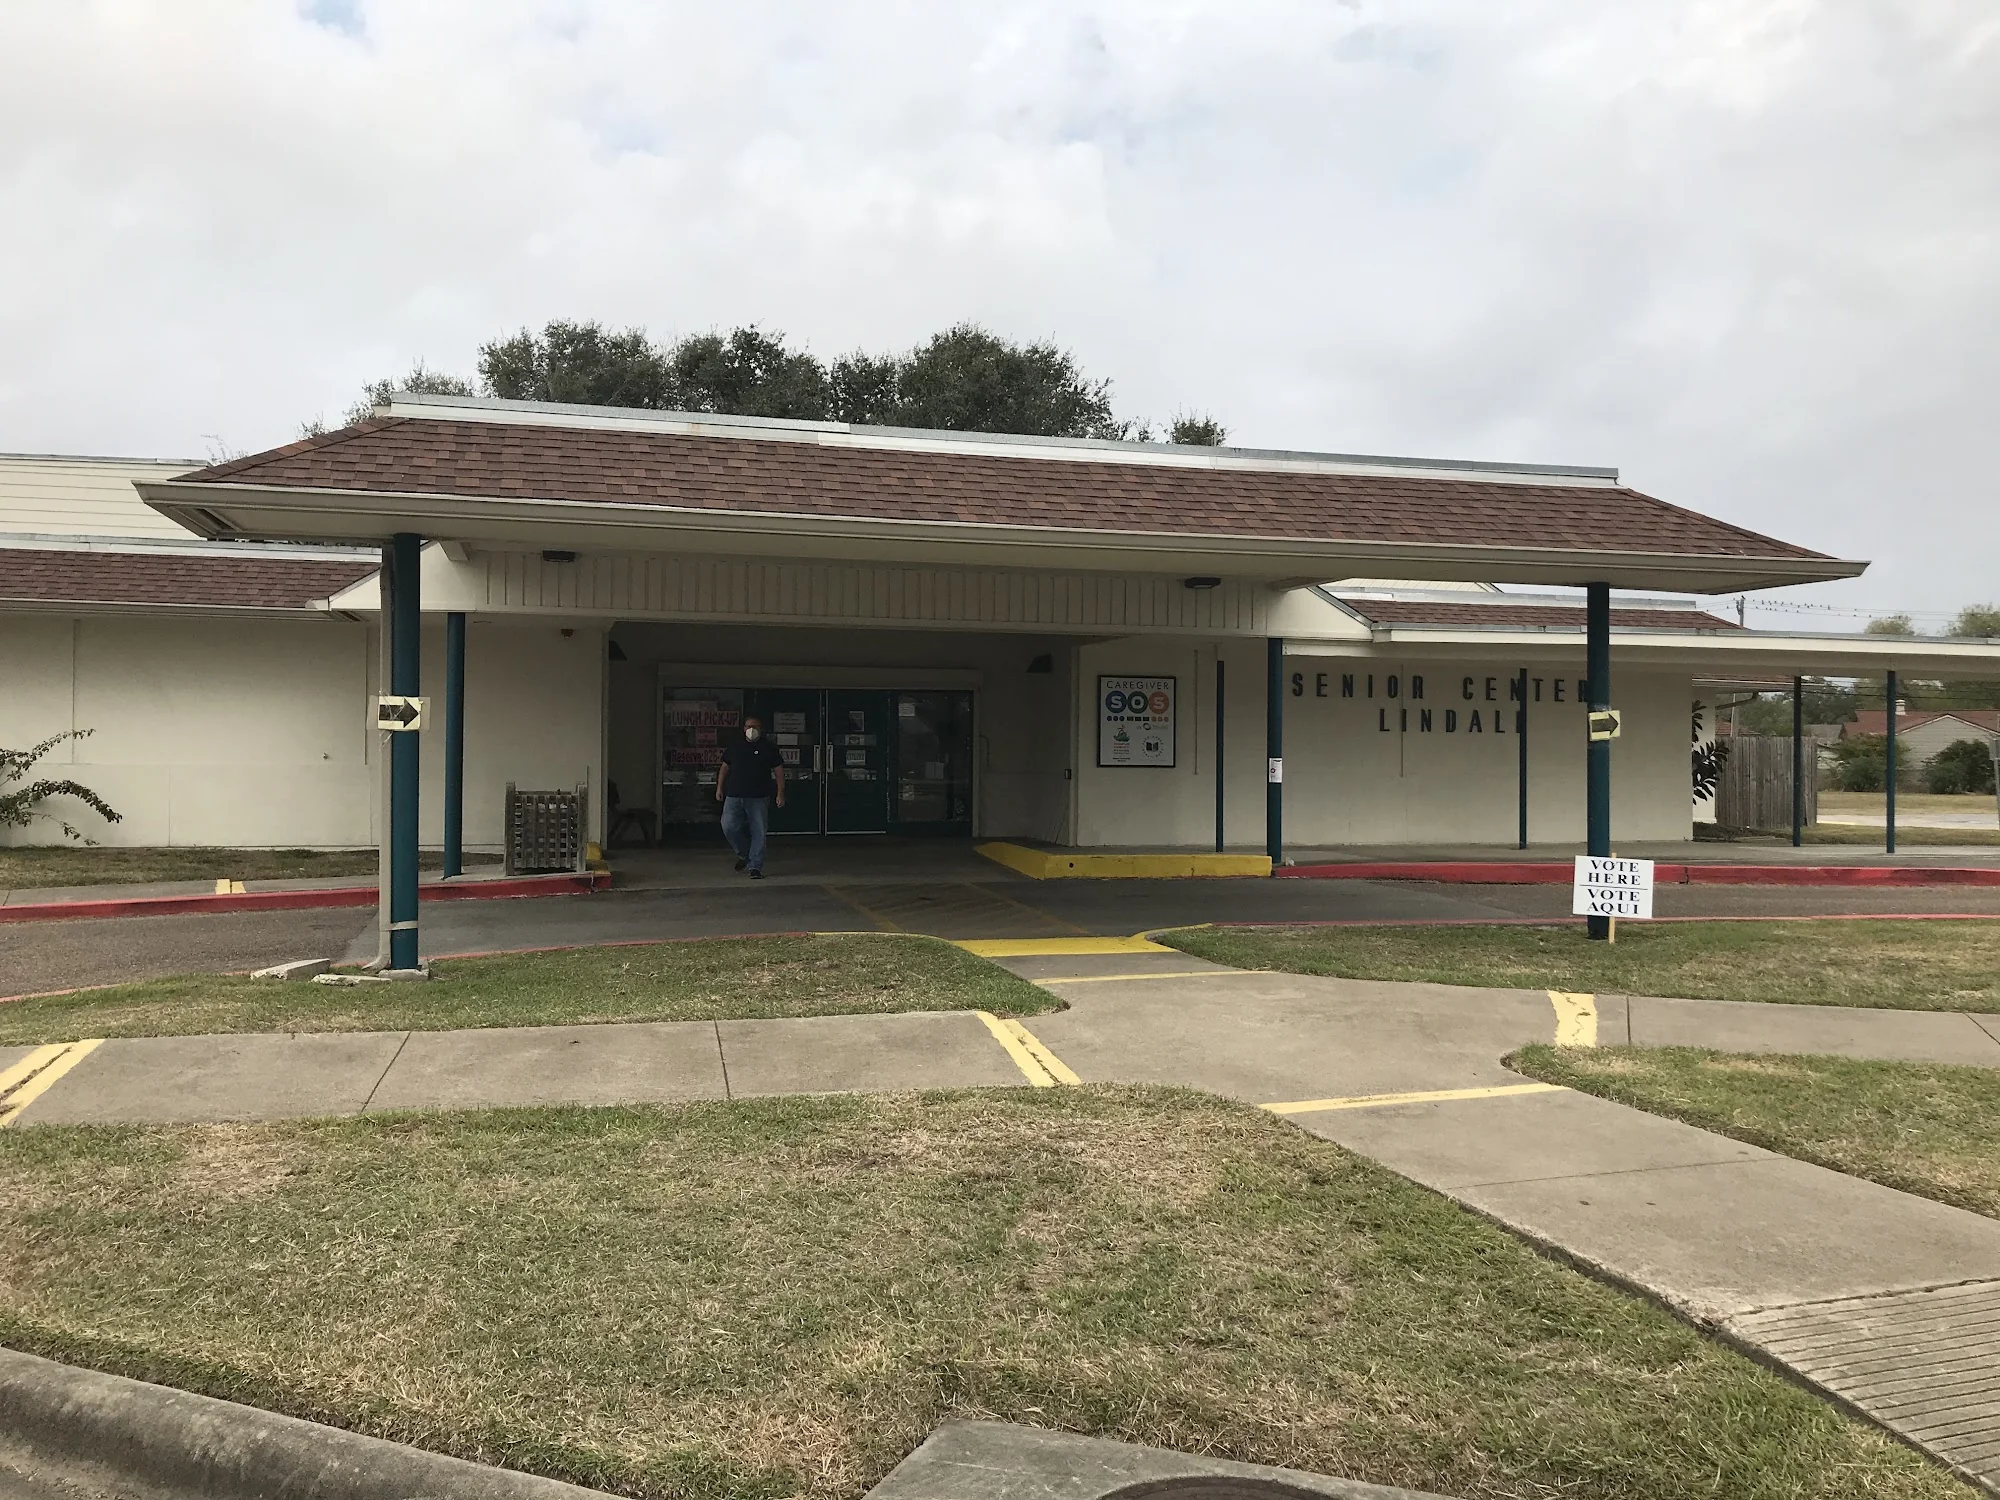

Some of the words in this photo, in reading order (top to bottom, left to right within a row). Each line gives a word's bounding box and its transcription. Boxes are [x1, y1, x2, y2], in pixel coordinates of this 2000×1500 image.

[1106, 680, 1169, 690] CAREGIVER
[1292, 672, 1423, 699] SENIOR
[1462, 676, 1588, 703] CENTER
[1108, 693, 1167, 711] SOS
[1379, 708, 1520, 734] LINDAL
[1591, 860, 1639, 873] VOTE
[1588, 872, 1641, 886] HERE
[1588, 888, 1640, 902] VOTE
[1587, 901, 1639, 915] AQUI
